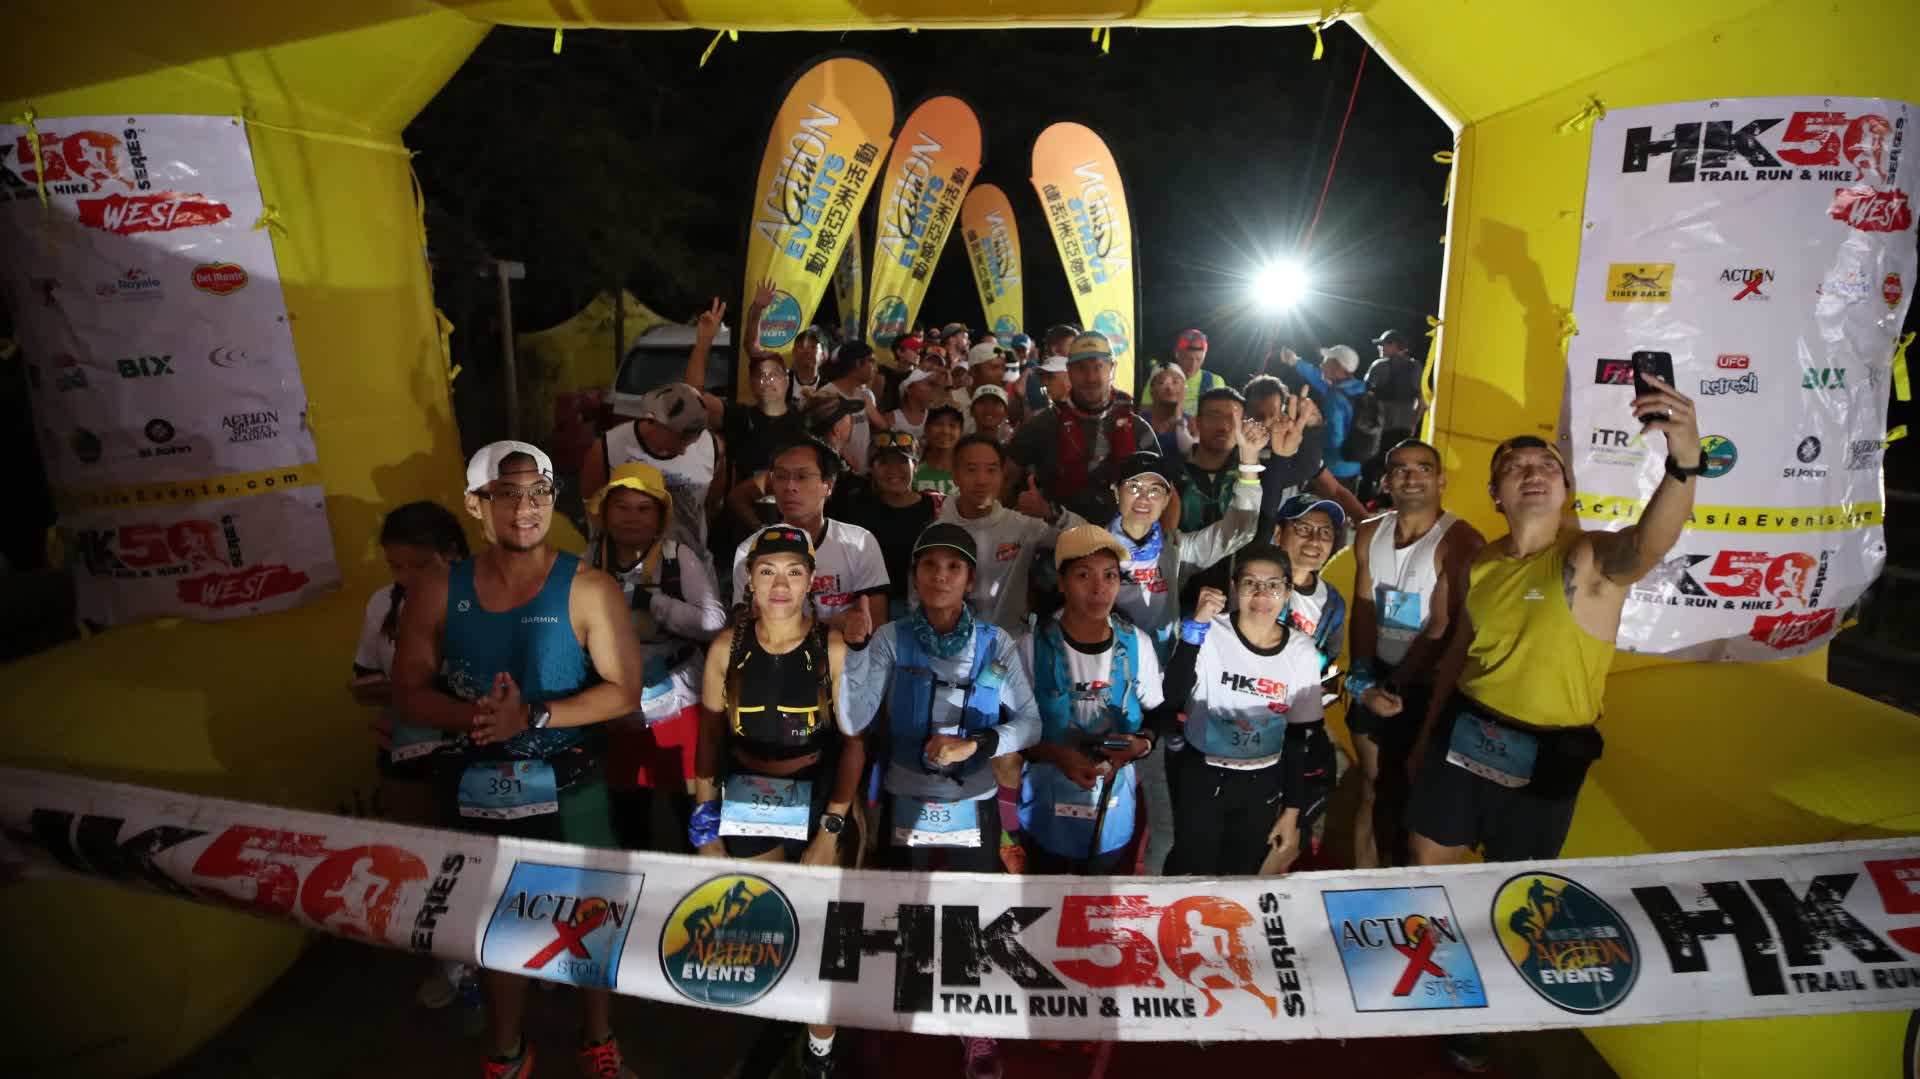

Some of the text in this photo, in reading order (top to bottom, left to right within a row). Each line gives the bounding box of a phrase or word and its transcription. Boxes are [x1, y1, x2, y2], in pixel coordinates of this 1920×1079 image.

[124, 128, 151, 190] SERIES
[1622, 111, 1893, 183] HK50
[54, 183, 90, 195] HIKE
[756, 103, 841, 252] ACTION
[1699, 169, 1853, 182] TRAIL RUN & HIKE
[103, 200, 178, 231] WEST
[783, 153, 846, 261] EVENTS
[805, 141, 879, 278] 動感亞洲活動
[1849, 196, 1905, 228] WEST
[898, 174, 945, 269] EVENTS
[117, 355, 175, 378] BIX
[1718, 358, 1748, 368] UFC
[222, 410, 280, 429] ACTION
[1784, 467, 1796, 478] St
[201, 570, 273, 606] WEST
[1685, 597, 1719, 609] RUN
[1723, 598, 1735, 610] &
[1741, 599, 1773, 611] HIKE
[520, 616, 559, 624] GARMIN
[1767, 613, 1834, 643] WEST
[1220, 671, 1288, 699] HK50
[1231, 731, 1262, 747] 374
[487, 777, 524, 796] 391
[750, 793, 784, 811] 357
[411, 852, 467, 953] ERIES
[500, 892, 629, 928] ACTION
[1341, 912, 1457, 951] ACTION
[687, 938, 785, 968] ACTION
[819, 894, 1262, 1014] HK50
[1258, 892, 1306, 1018] SERIES
[682, 961, 757, 983] EVENTS
[1540, 967, 1615, 984] EVENTS
[1790, 969, 1868, 994] TRAIL
[1424, 977, 1478, 997] STORE
[940, 992, 1197, 1018] TRAIL RUN & HIKE
